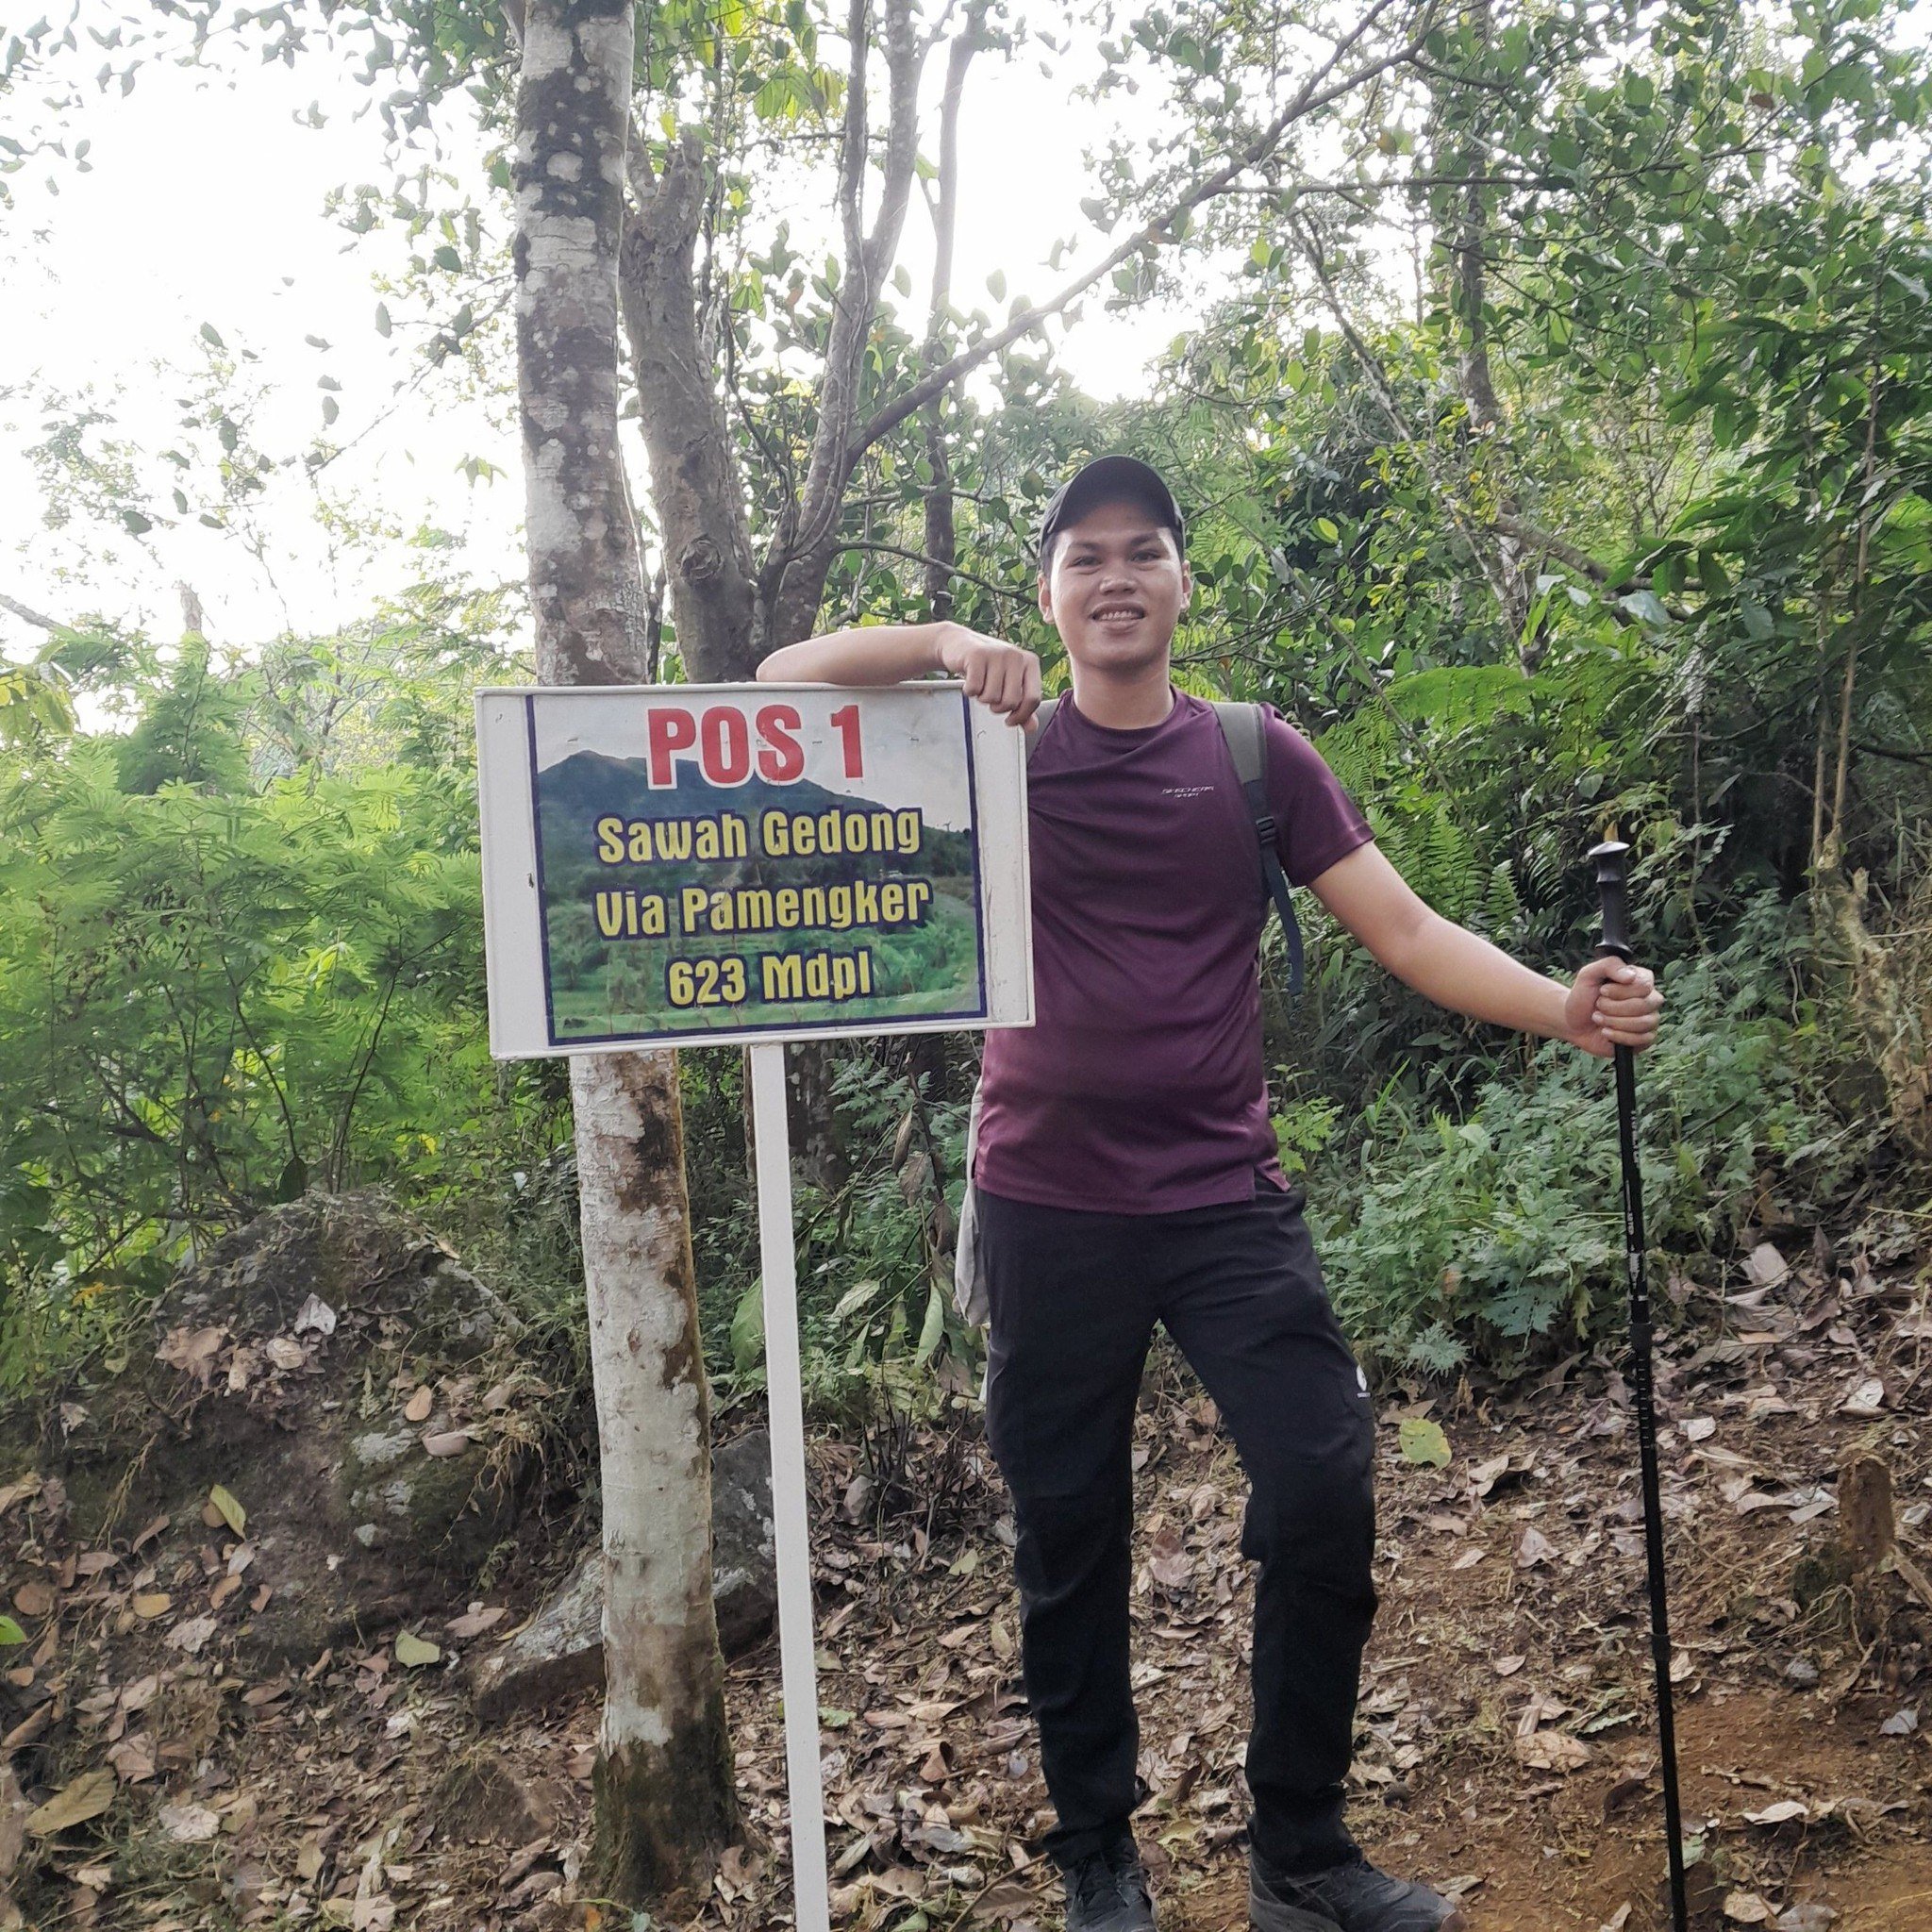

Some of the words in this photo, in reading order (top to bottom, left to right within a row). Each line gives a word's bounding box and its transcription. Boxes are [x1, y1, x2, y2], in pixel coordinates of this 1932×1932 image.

[647, 704, 805, 785] POS
[829, 704, 864, 778] 1
[596, 812, 747, 863] Sawah
[762, 808, 921, 857] Gedong
[595, 891, 666, 938] Via
[682, 879, 930, 933] Pamengker
[668, 958, 745, 1006] 623
[761, 949, 871, 1000] Mdpl
